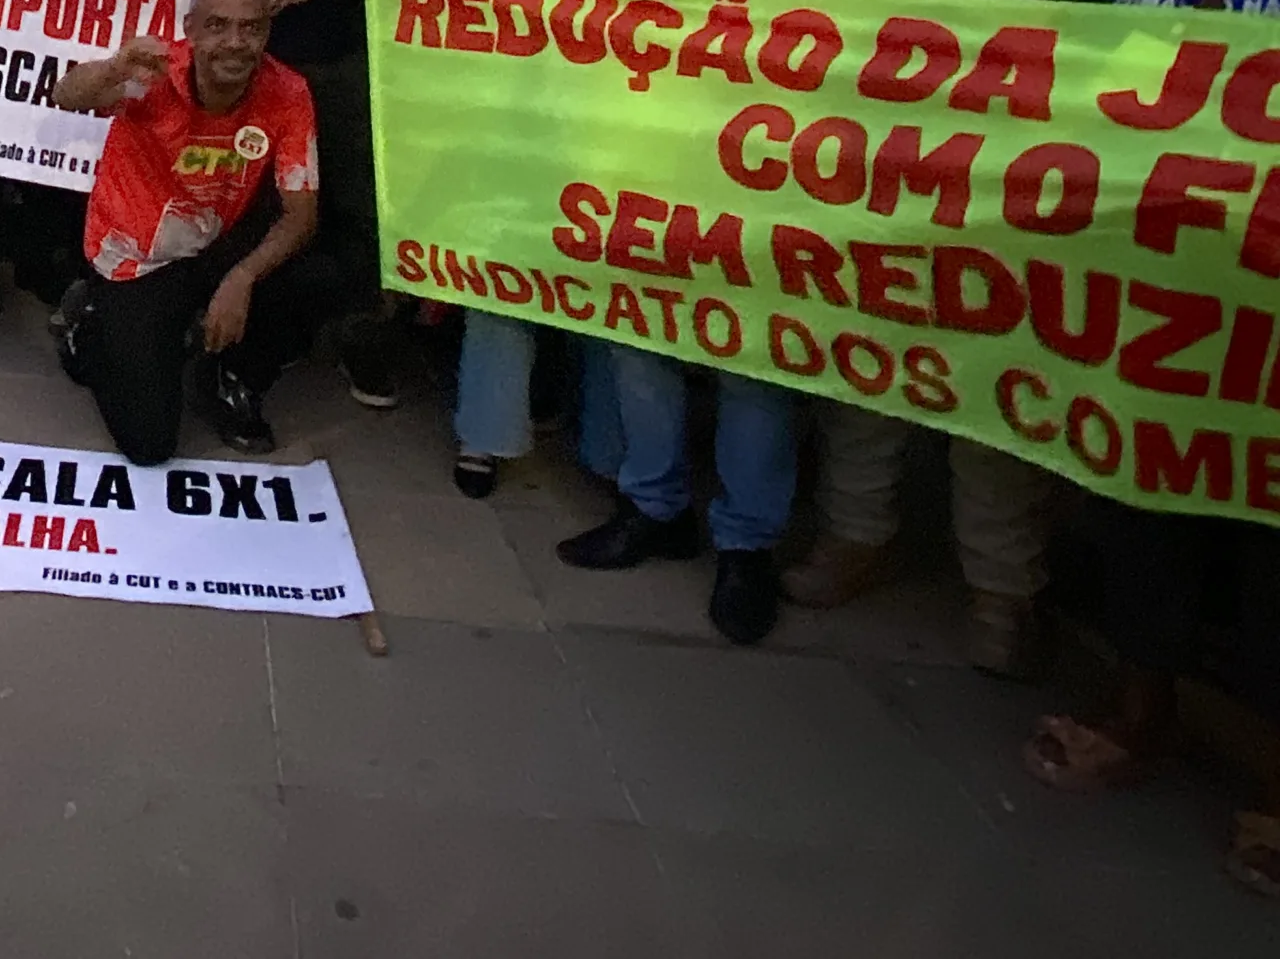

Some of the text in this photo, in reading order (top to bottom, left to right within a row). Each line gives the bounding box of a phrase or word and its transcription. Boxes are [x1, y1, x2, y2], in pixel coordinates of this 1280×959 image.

[858, 17, 1059, 122] DA
[27, 145, 36, 163] à
[39, 148, 66, 169] CUT
[69, 157, 77, 172] e
[81, 159, 90, 174] a
[718, 103, 984, 229] COM
[1003, 142, 1100, 236] O
[553, 182, 752, 288] SEM
[395, 240, 1280, 513] SINDICATO DOS COME
[167, 469, 327, 522] 6X1.
[42, 567, 347, 601] Filiado à CUT e a CONTRACS-CUT
